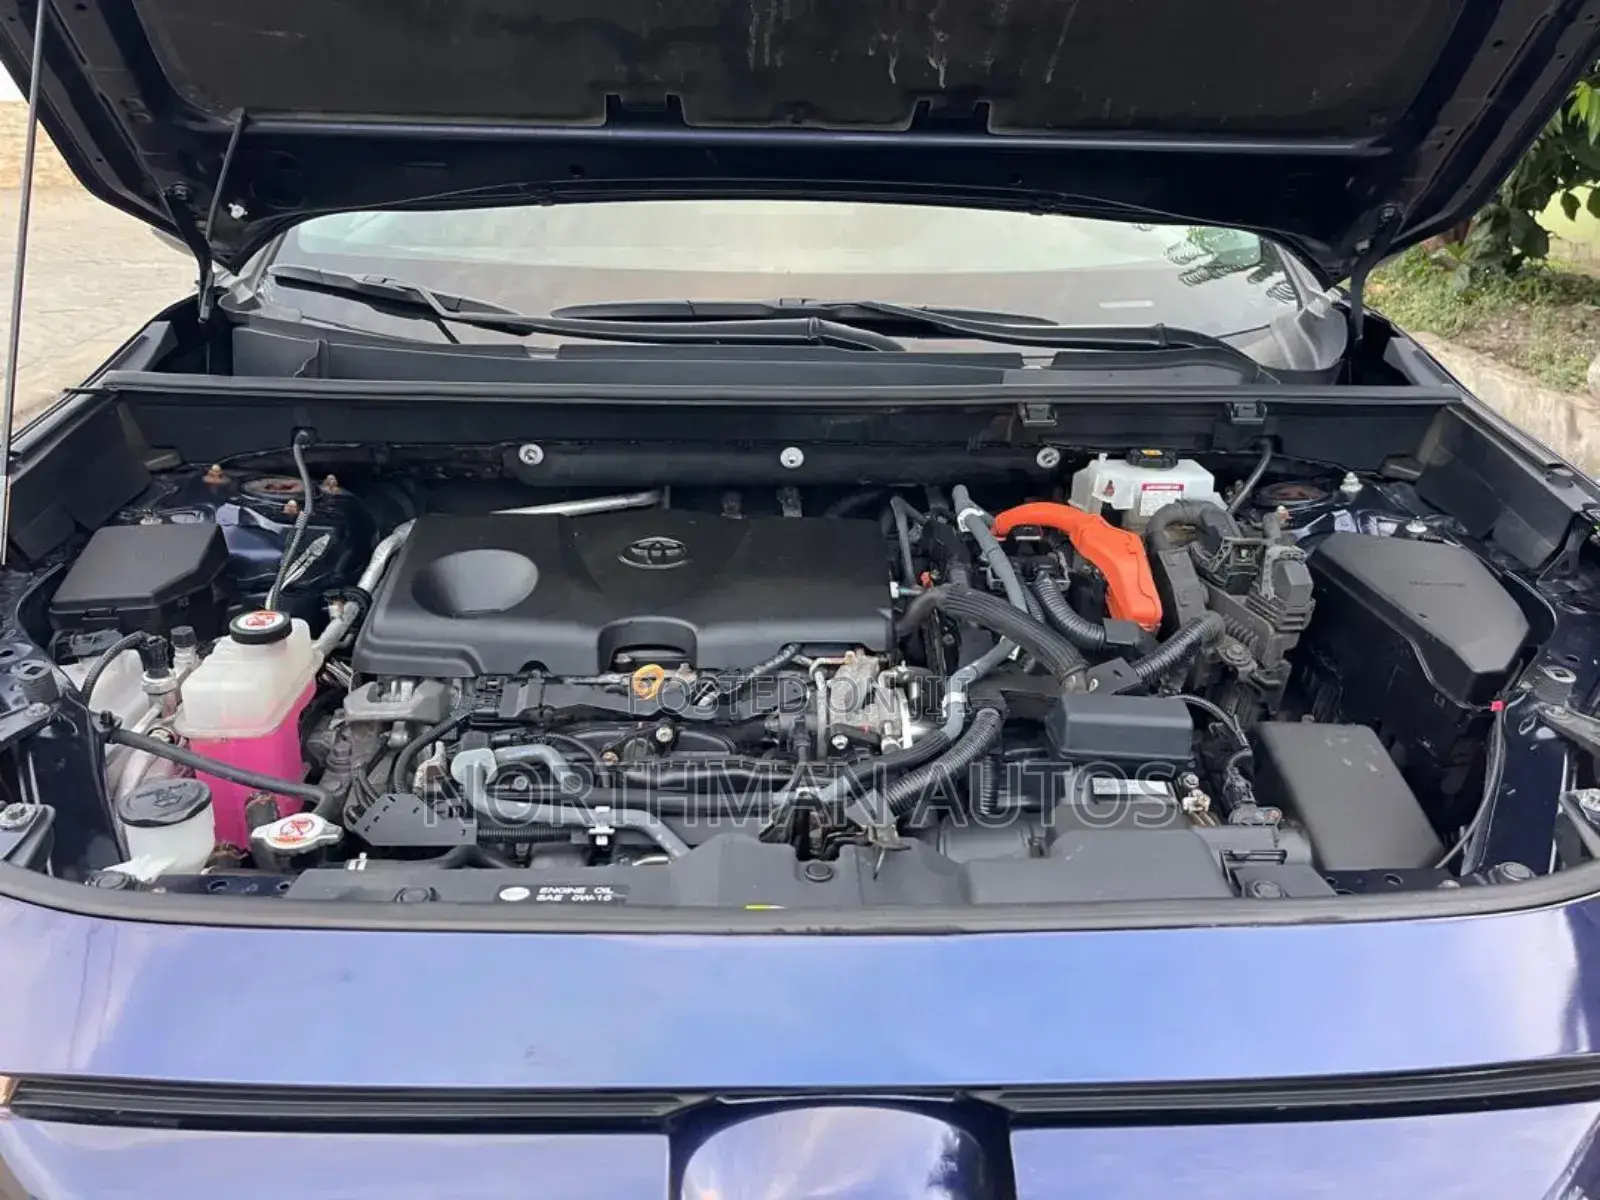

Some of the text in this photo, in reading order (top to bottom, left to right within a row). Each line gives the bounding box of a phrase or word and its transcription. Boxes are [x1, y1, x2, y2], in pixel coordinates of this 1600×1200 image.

[539, 886, 614, 895] ENGINE OIL
[536, 894, 563, 902] SAE
